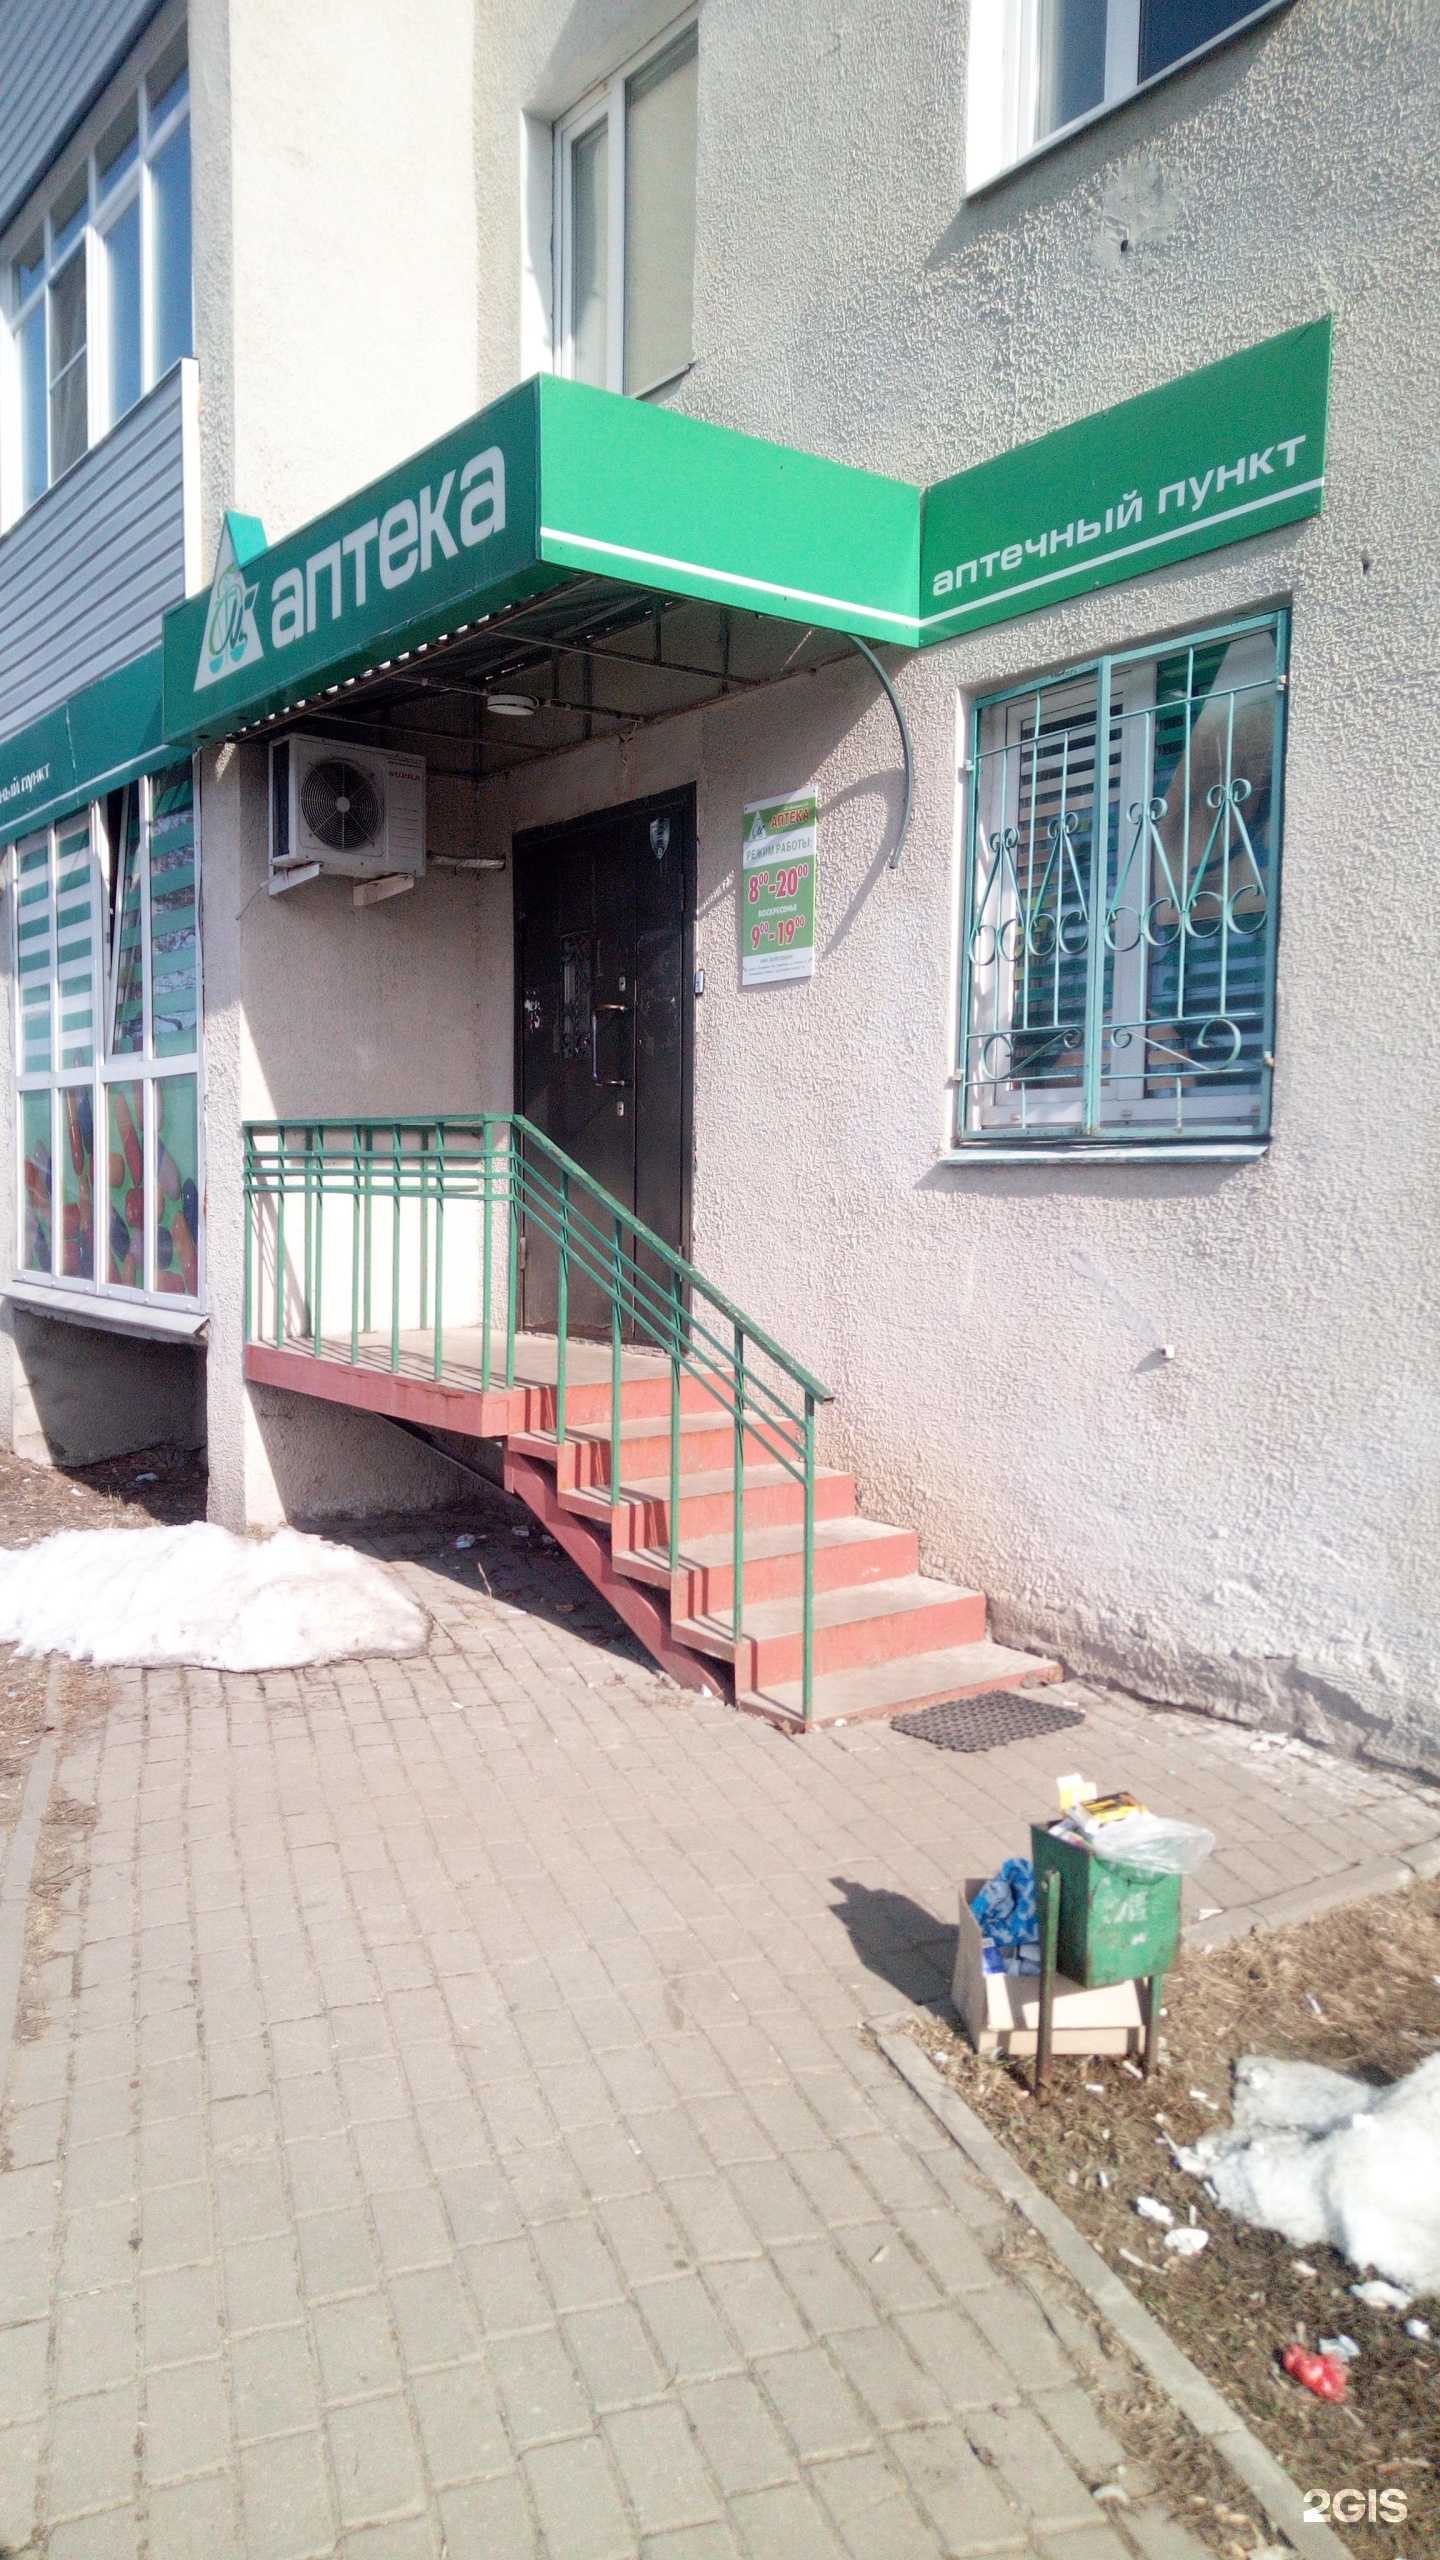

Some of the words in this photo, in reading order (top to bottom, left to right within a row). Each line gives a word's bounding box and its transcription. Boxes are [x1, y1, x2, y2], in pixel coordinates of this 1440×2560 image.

[932, 489, 1144, 597] аптечный
[1157, 434, 1307, 513] пункт
[271, 445, 506, 649] аптека
[21, 762, 50, 792] пункт
[771, 807, 810, 828] АПТЕКА
[746, 844, 775, 861] РЕЖИМ
[775, 837, 810, 854] РАБОТЫ
